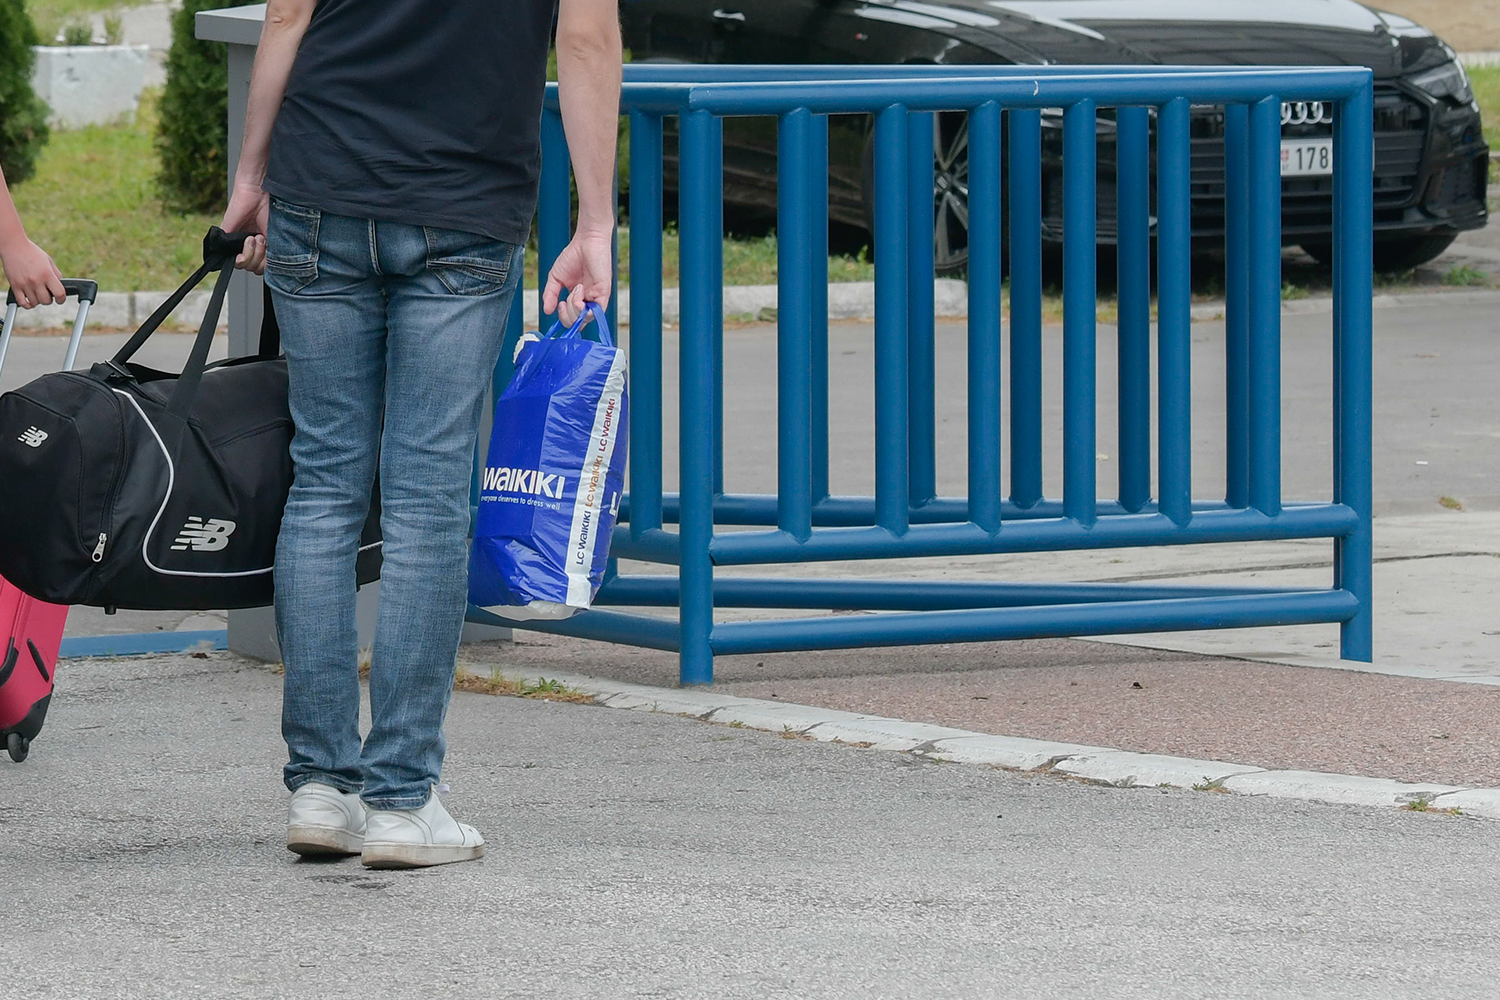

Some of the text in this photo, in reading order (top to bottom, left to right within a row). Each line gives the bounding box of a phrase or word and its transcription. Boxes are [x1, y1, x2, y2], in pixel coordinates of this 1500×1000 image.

[1296, 147, 1329, 170] 178
[520, 497, 526, 505] to
[526, 498, 544, 507] dress
[545, 502, 561, 511] well
[575, 550, 585, 565] LC
